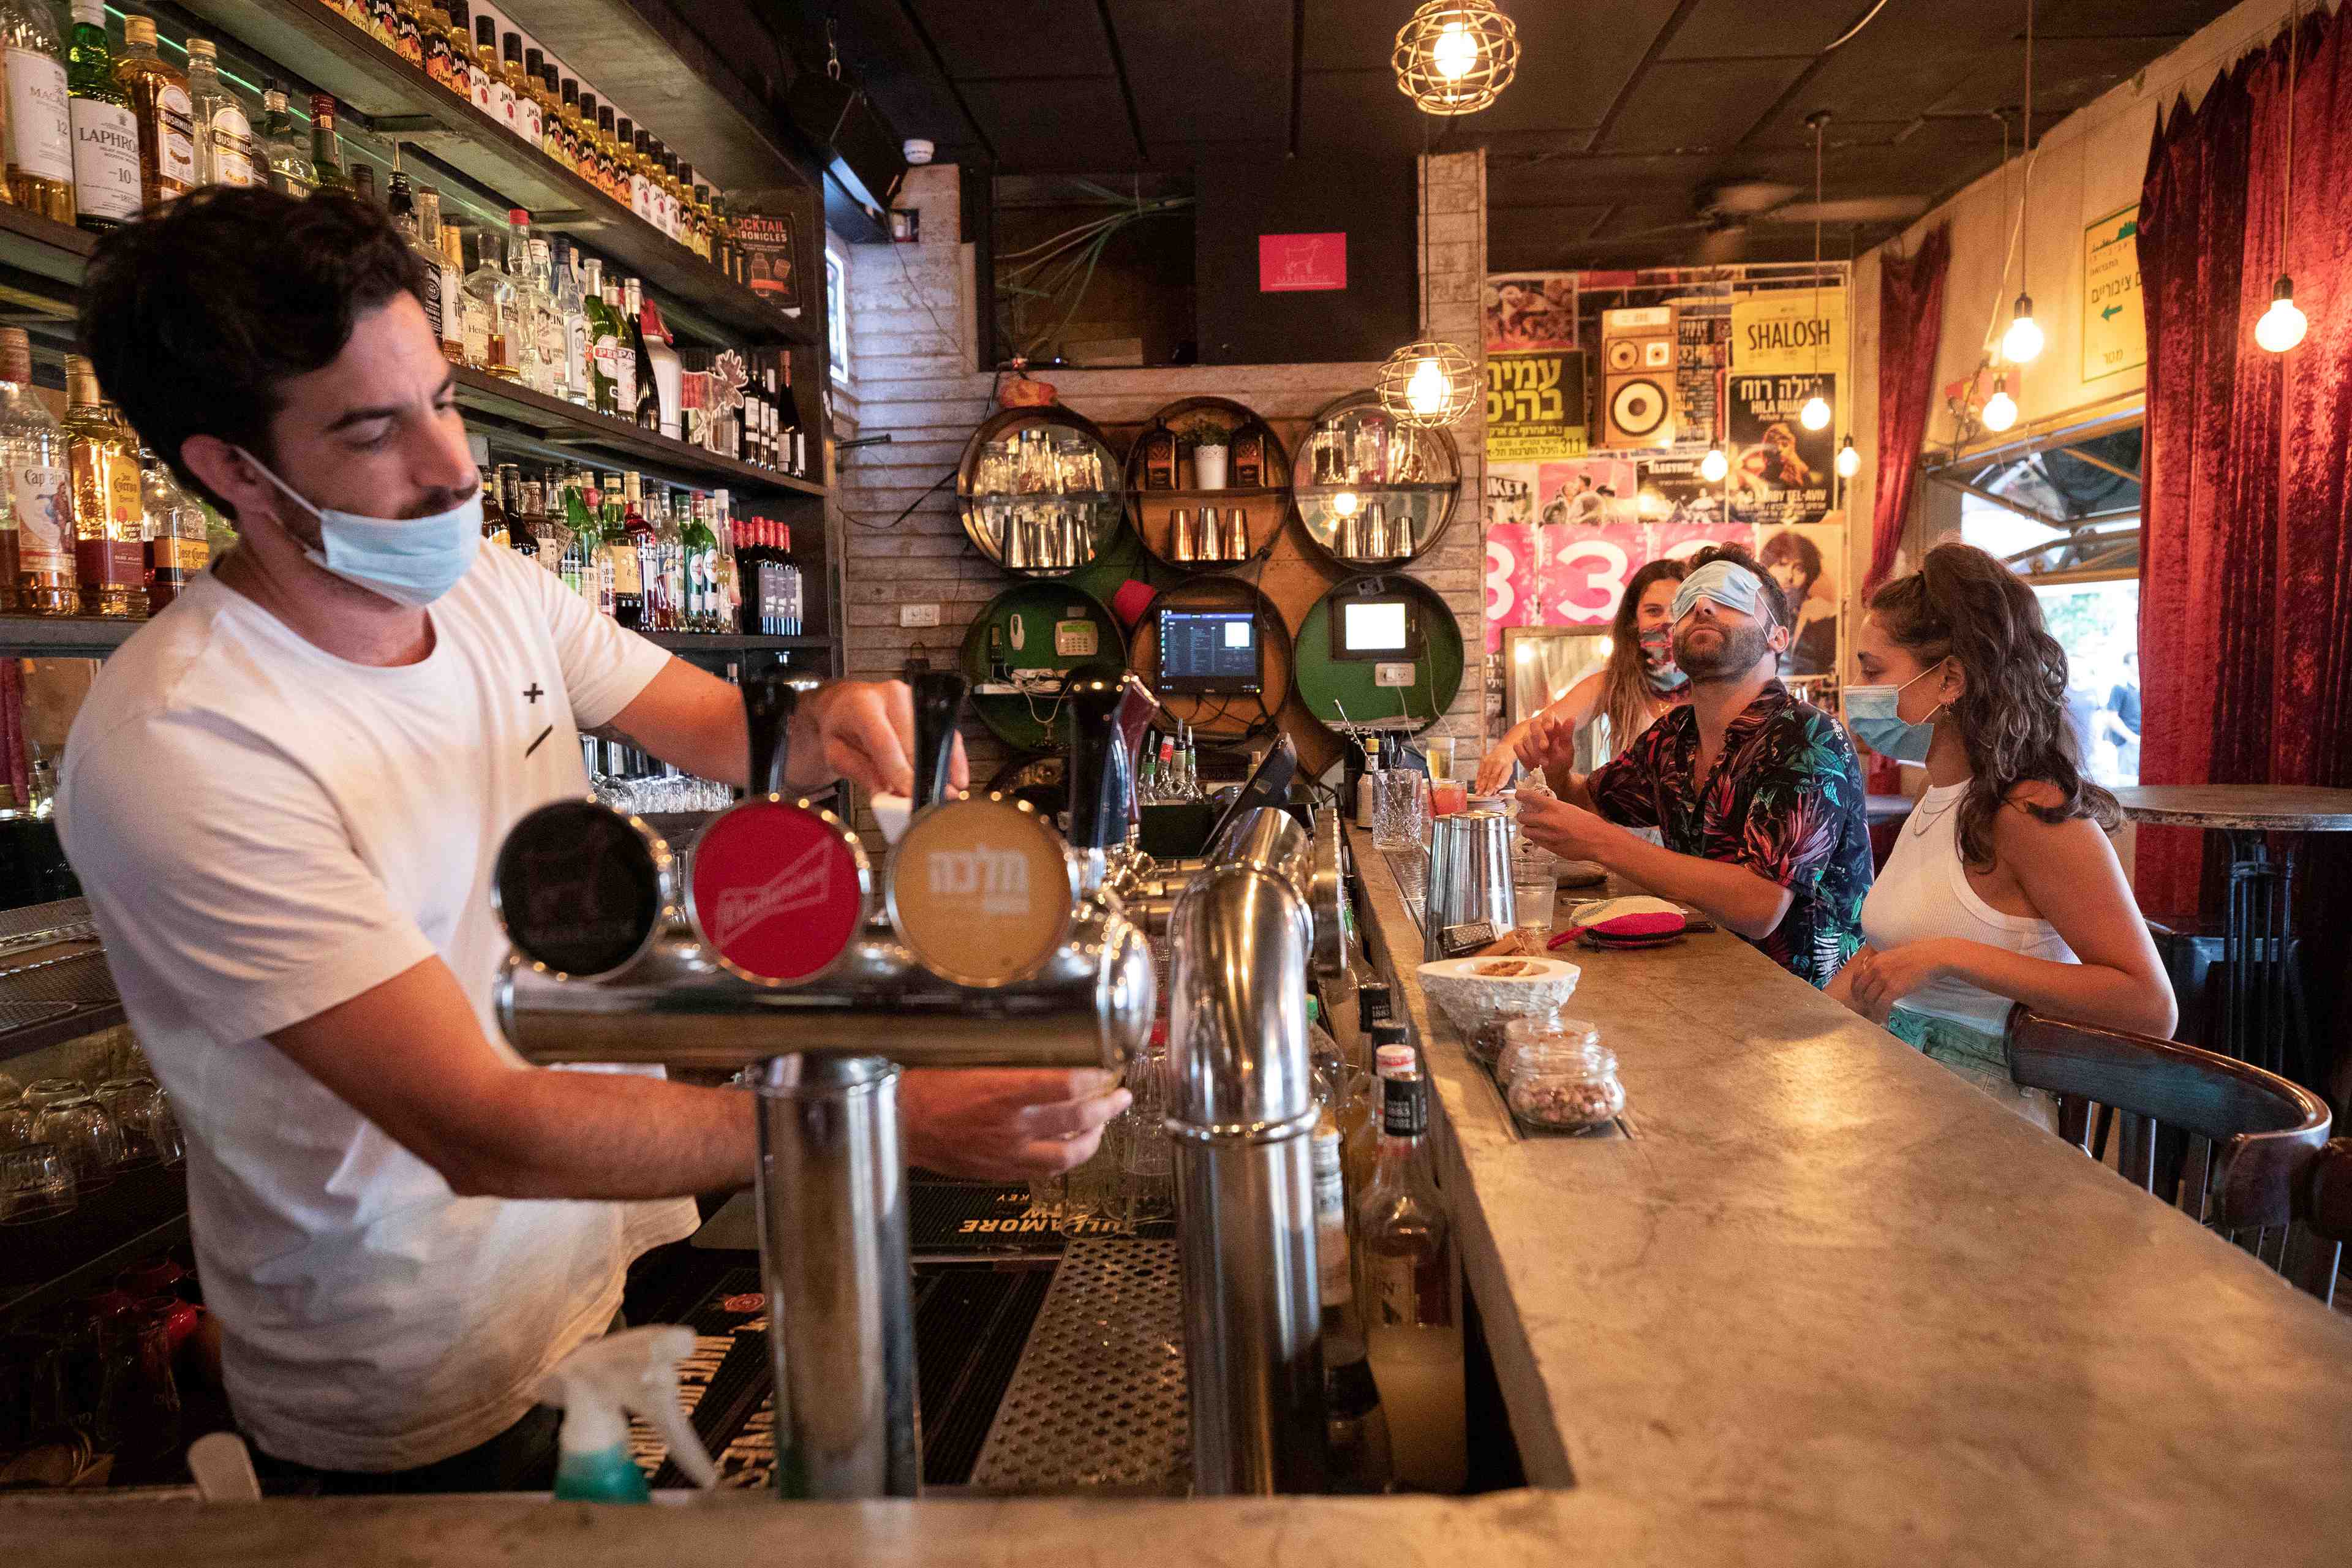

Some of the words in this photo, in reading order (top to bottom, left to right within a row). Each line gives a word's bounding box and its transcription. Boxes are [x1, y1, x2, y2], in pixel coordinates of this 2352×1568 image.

[374, 1, 385, 14] JIM
[399, 21, 410, 35] JIM
[57, 119, 67, 136] 12
[79, 127, 138, 153] LAPHRO
[214, 132, 252, 156] BUSHMILLS
[118, 168, 131, 184] 10
[739, 218, 785, 233] OCKTAIL
[739, 230, 788, 243] RONICLES
[2092, 274, 2132, 304] ציבוריים
[1747, 318, 1830, 351] SHALOSH
[1741, 379, 1772, 401] רוח
[1751, 399, 1776, 414] HILA
[1560, 437, 1581, 454] 31.1
[1556, 540, 1628, 623] 3
